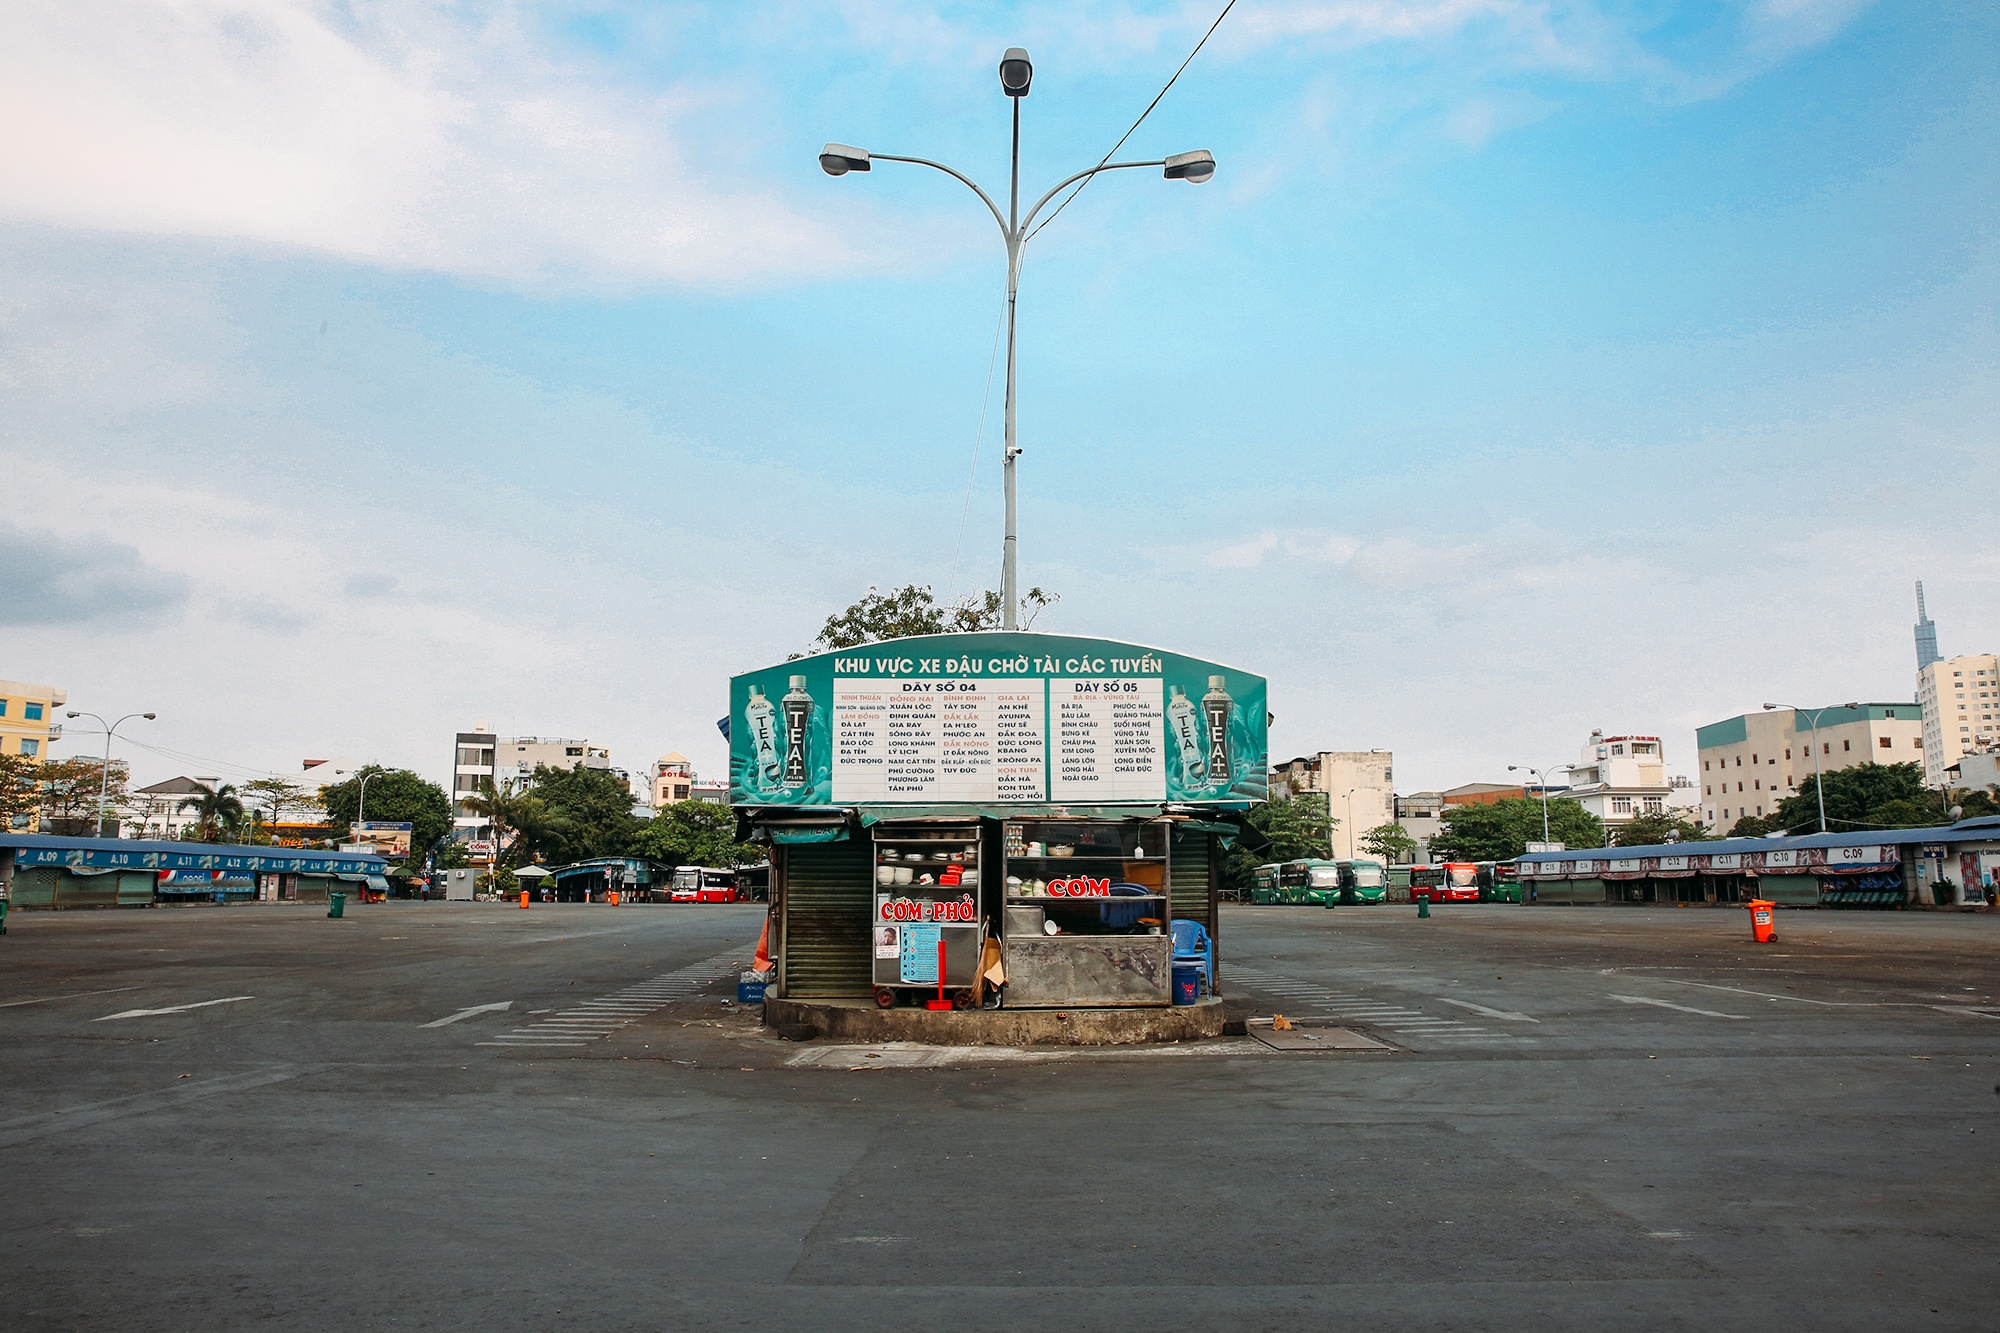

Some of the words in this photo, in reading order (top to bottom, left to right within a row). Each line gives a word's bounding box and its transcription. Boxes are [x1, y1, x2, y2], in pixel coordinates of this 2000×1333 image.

[834, 658, 870, 673] KHU
[876, 657, 913, 676] VỰC
[919, 658, 940, 673] XE
[946, 656, 982, 677] ĐẬU
[988, 655, 1029, 674] CHỜ
[1034, 655, 1060, 673] TÀI
[1066, 654, 1105, 673] CÁC
[1110, 652, 1162, 673] TUYẾN
[902, 682, 931, 691] DÃY
[936, 680, 955, 692] SỐ
[1075, 681, 1099, 692] DÃY
[1104, 679, 1120, 692] SỐ
[1124, 683, 1137, 692] 05
[38, 852, 57, 861] A.09
[111, 854, 128, 864] A.10
[1774, 852, 1788, 862] C.10
[1843, 849, 1862, 859] C.09
[178, 857, 192, 865] A.11
[227, 859, 240, 867] A.12
[1719, 856, 1732, 864] C.11
[1047, 875, 1110, 897] CƠM
